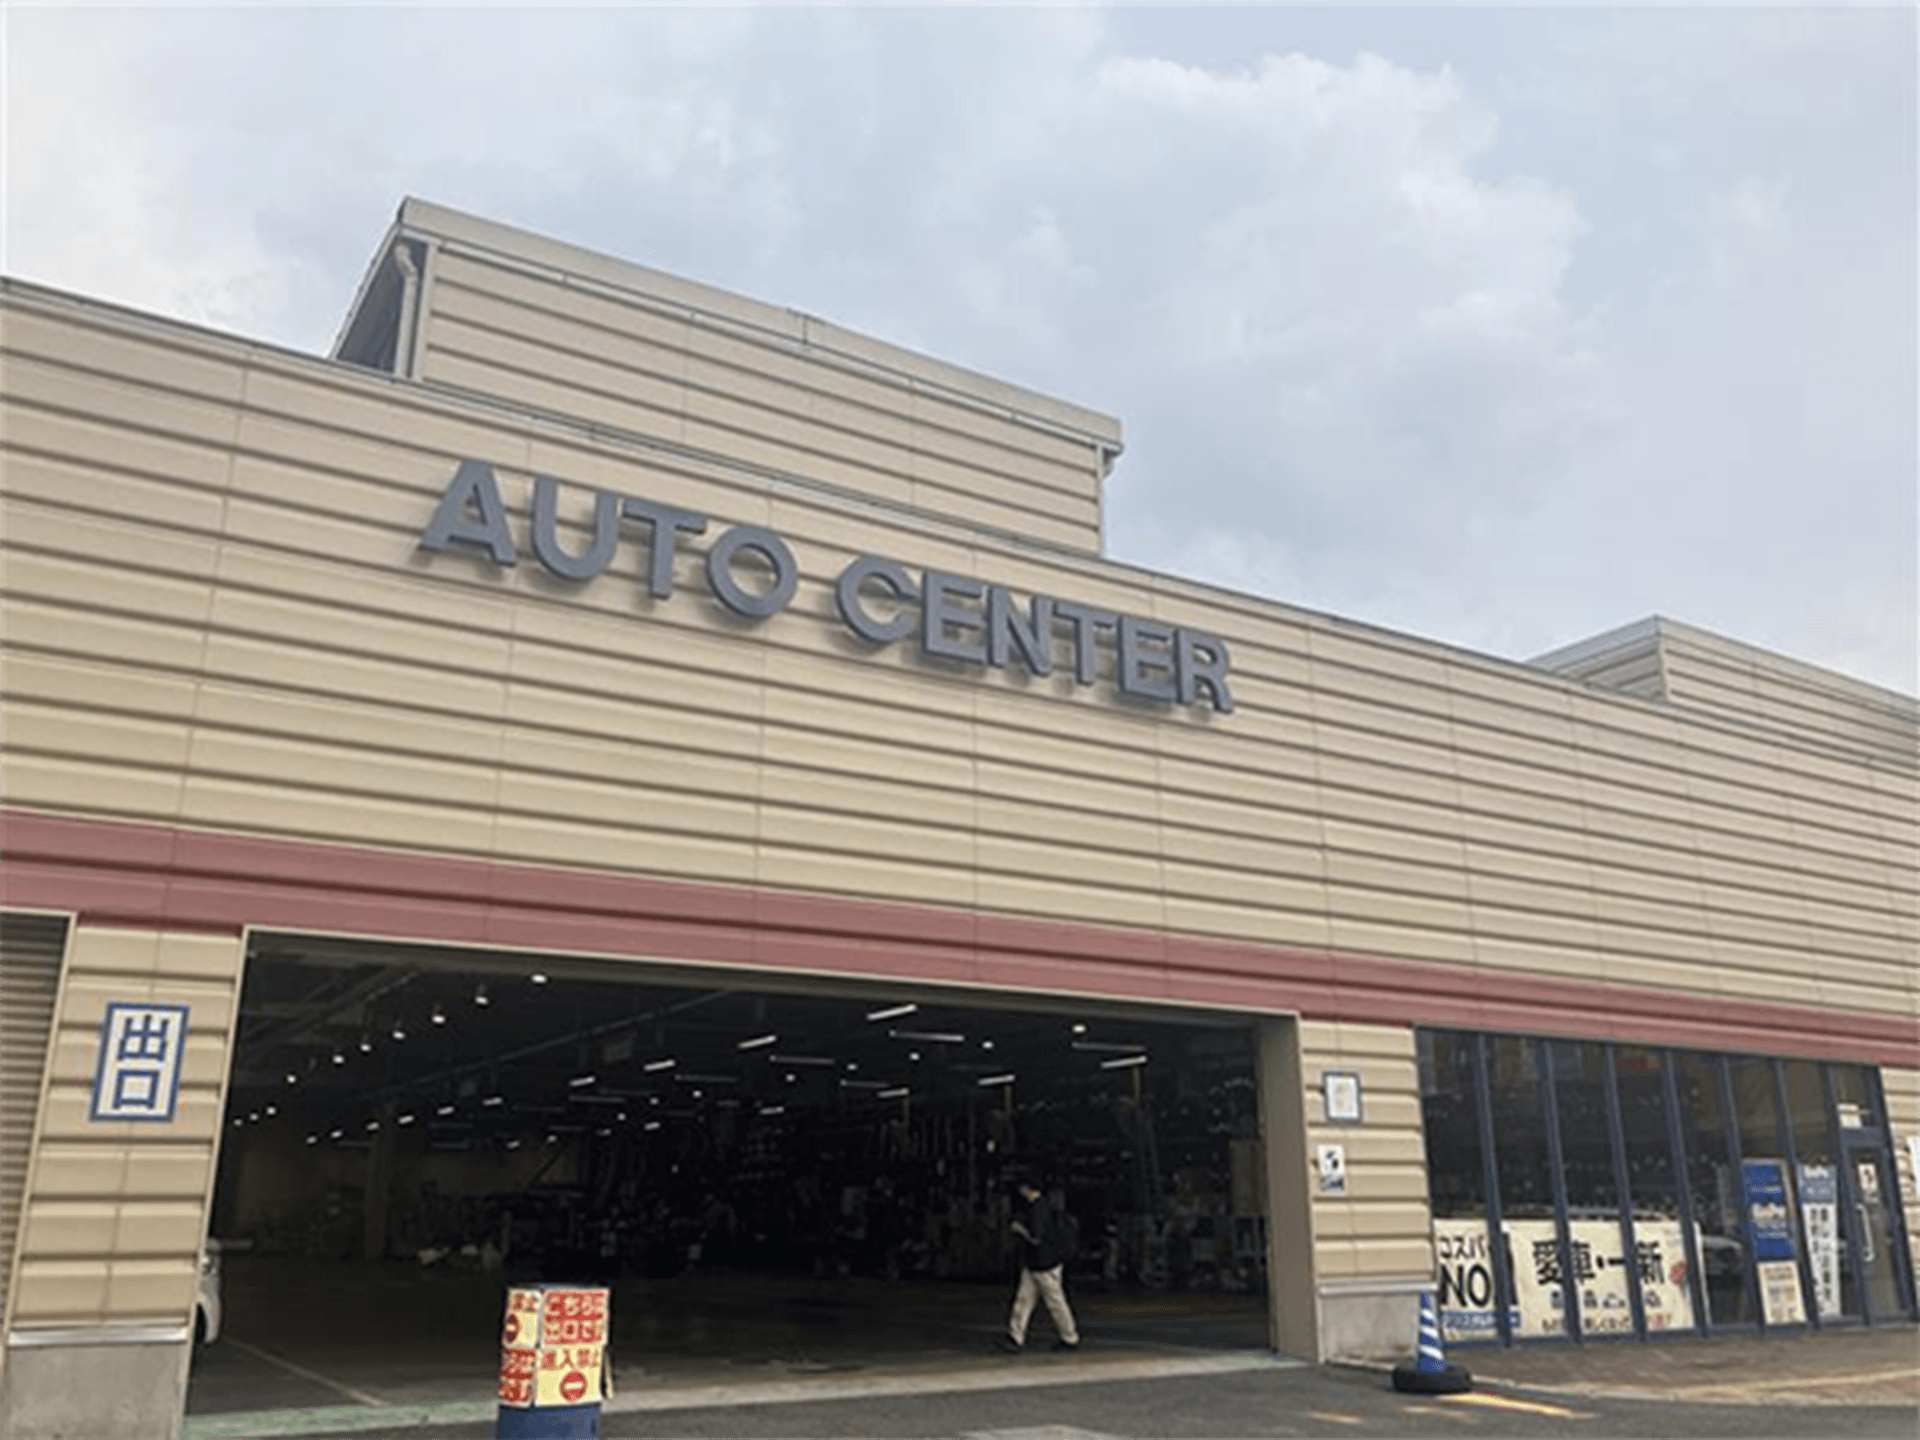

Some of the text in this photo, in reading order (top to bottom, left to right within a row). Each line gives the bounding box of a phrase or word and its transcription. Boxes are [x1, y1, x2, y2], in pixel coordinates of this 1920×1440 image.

[420, 460, 1234, 713] AUTO CENTER
[111, 1014, 169, 1110] 出口
